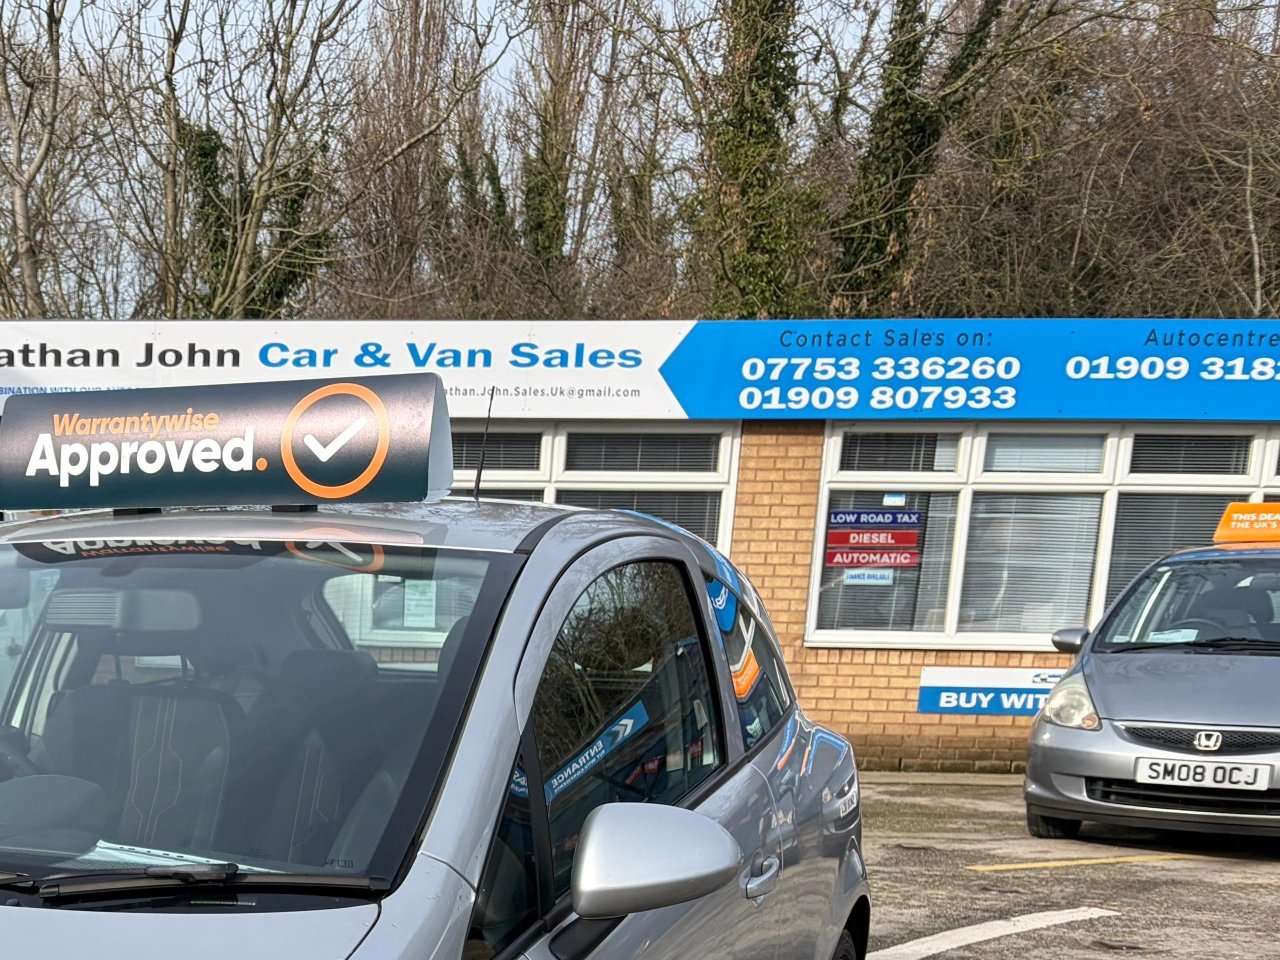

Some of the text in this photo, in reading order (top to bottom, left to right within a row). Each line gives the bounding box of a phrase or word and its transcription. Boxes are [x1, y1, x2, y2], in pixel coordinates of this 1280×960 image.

[780, 328, 992, 347] Contact Sales on:
[1144, 328, 1280, 347] Autocentre
[136, 342, 241, 368] John
[258, 342, 338, 368] Car
[353, 342, 391, 368] &
[406, 342, 492, 368] Van
[508, 342, 643, 369] Sales
[741, 356, 1021, 381] 07753 336260
[1065, 355, 1280, 381] 01909 318
[444, 386, 640, 399] athan.John.Sales.Uk@gmail.com
[738, 386, 1017, 410] 01909 807933
[53, 408, 220, 438] Warrantywise
[25, 426, 269, 487] Approved.
[830, 513, 919, 523] LOW ROAD TAX
[849, 533, 896, 544] DIESEL
[832, 553, 912, 564] AUTOMATIC
[939, 692, 1049, 710] BUY WIT
[1148, 762, 1259, 786] SM08 OCJ
